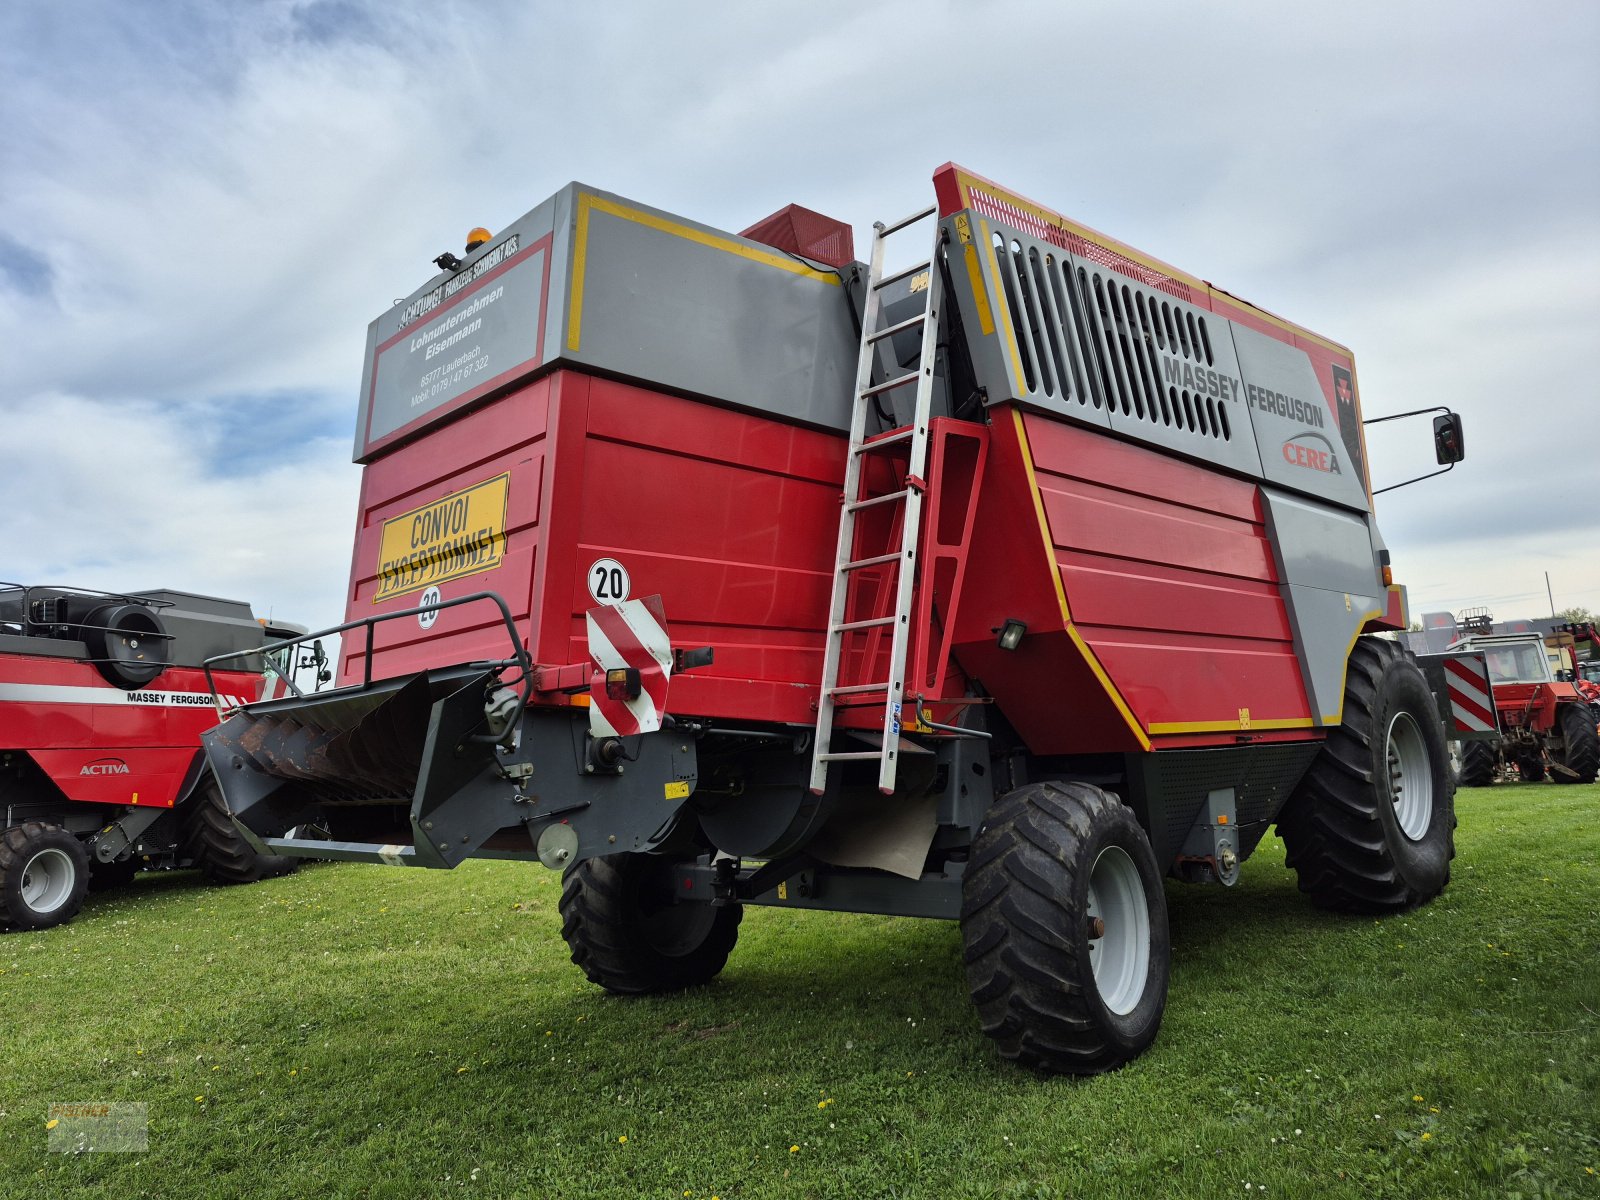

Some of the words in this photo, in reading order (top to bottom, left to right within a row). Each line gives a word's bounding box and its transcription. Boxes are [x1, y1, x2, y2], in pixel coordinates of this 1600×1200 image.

[444, 269, 473, 299] FAHRZEUG
[473, 244, 505, 279] SCHWENKT
[410, 285, 504, 353] Lohnunternehmen
[425, 317, 482, 361] Eisenmann
[431, 378, 448, 396] 0179
[453, 369, 463, 383] 47
[463, 363, 474, 378] 67
[474, 355, 489, 373] 322
[442, 345, 481, 375] Lauterbach
[1163, 356, 1239, 403] MASSEY
[1248, 383, 1325, 429] FERGUSON
[1282, 442, 1342, 475] CEREA
[410, 495, 470, 549] CONVOI
[382, 527, 496, 594] EXCEPTIONNEL
[595, 566, 623, 599] 20
[421, 591, 438, 622] 20
[127, 692, 166, 704] MASSEY
[171, 694, 215, 705] FERGUSON
[80, 763, 130, 775] ACTIVA
